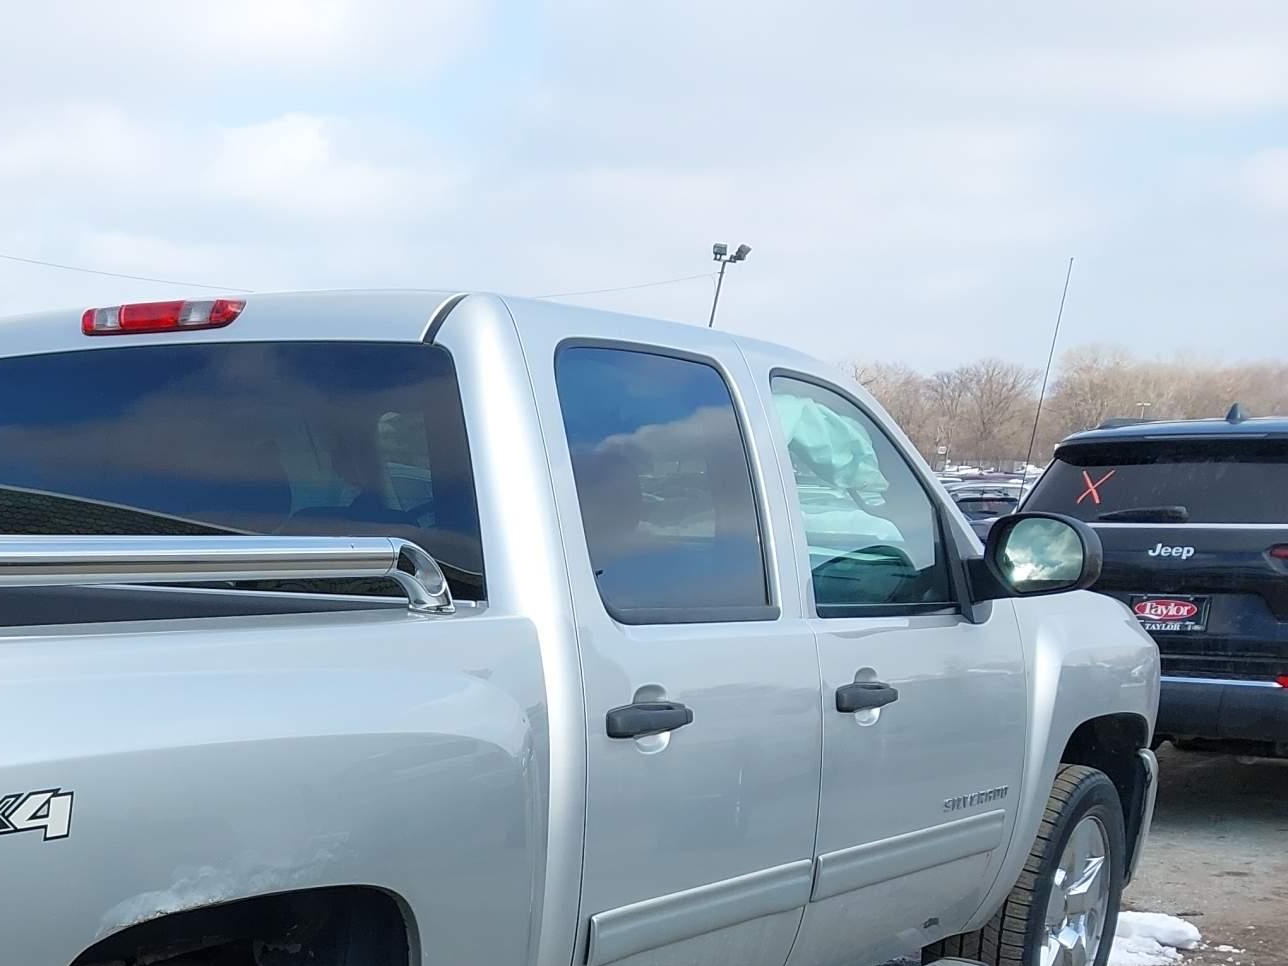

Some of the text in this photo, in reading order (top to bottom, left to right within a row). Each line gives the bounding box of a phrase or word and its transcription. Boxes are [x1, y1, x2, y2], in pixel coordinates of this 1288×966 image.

[1148, 543, 1195, 560] Jeep
[1143, 602, 1193, 618] Taylor
[1144, 623, 1181, 631] TAYLOR
